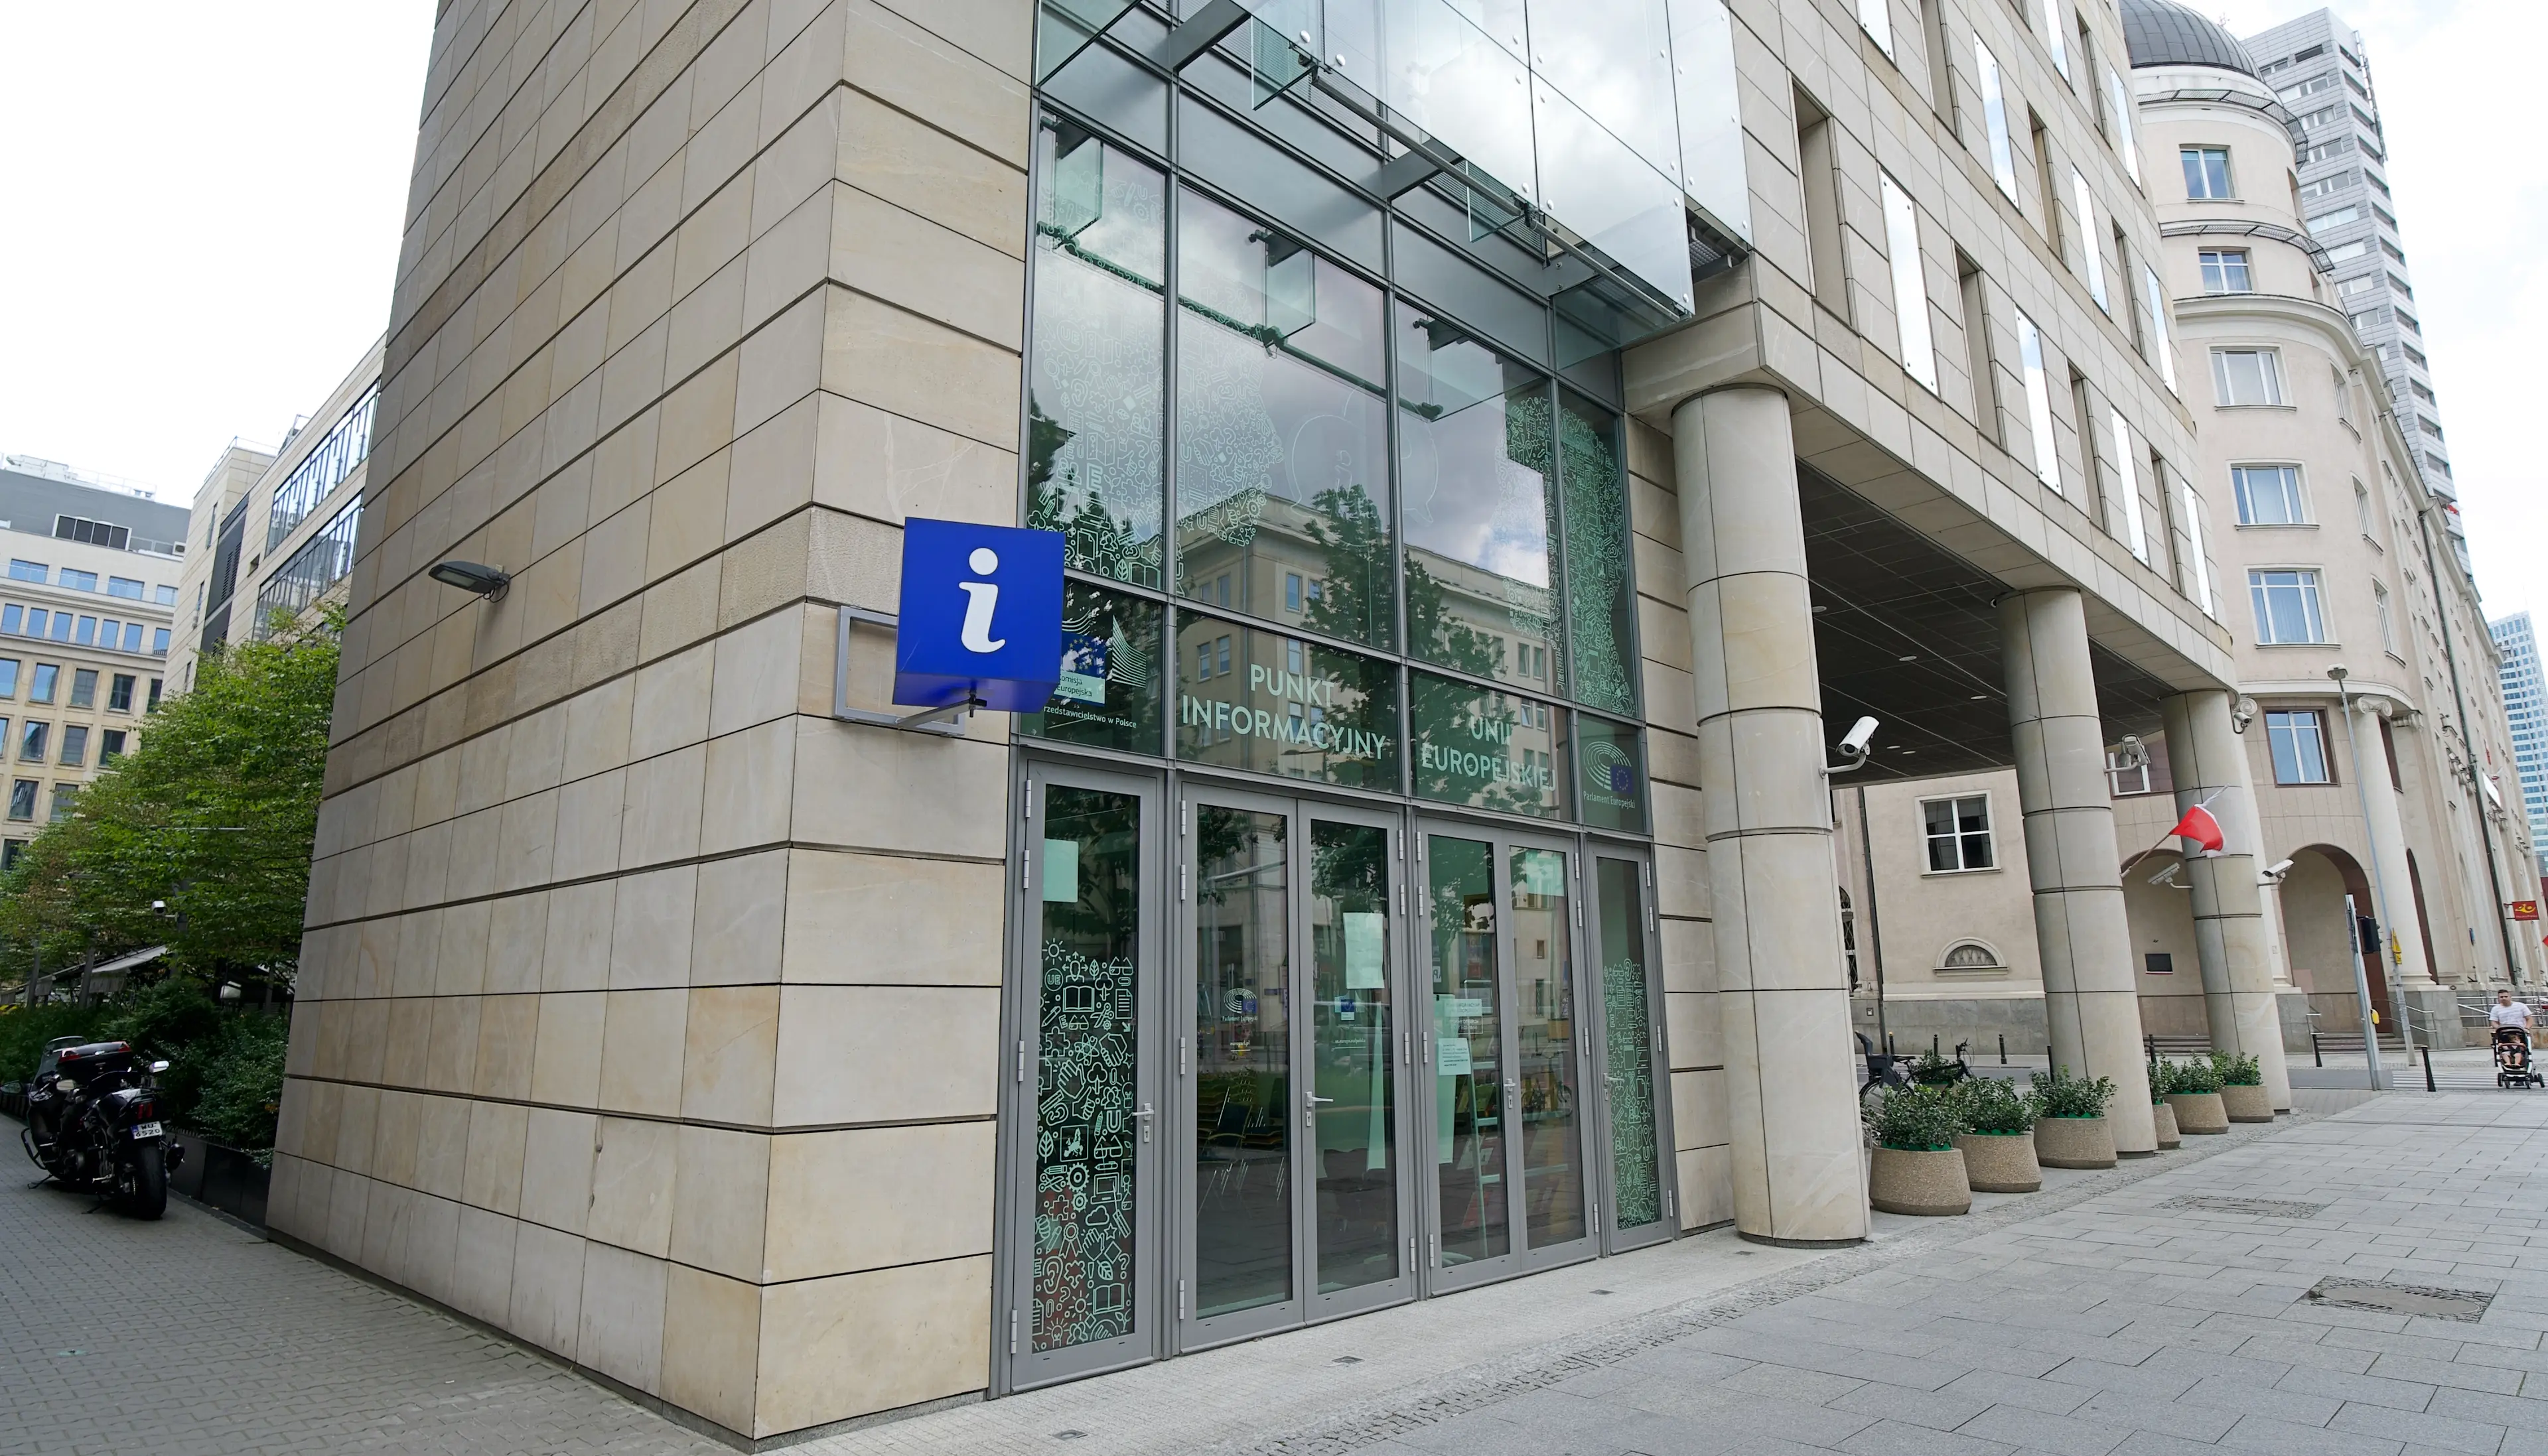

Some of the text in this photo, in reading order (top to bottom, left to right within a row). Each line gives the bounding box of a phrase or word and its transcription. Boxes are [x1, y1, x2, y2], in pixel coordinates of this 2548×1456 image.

[959, 547, 1006, 653] i
[1060, 674, 1083, 686] omisja
[1250, 663, 1334, 708] PUNKT
[1044, 705, 1106, 723] rzedstawicielstwo
[1115, 717, 1137, 728] Polsce
[1182, 695, 1386, 760] INFORMACYJNY
[1470, 715, 1510, 746] UNII
[1421, 742, 1556, 792] EUROPEJSKIEJ
[1583, 790, 1635, 809] Parlament Europejski
[1047, 974, 1060, 985] UE
[135, 1128, 160, 1137] 6520
